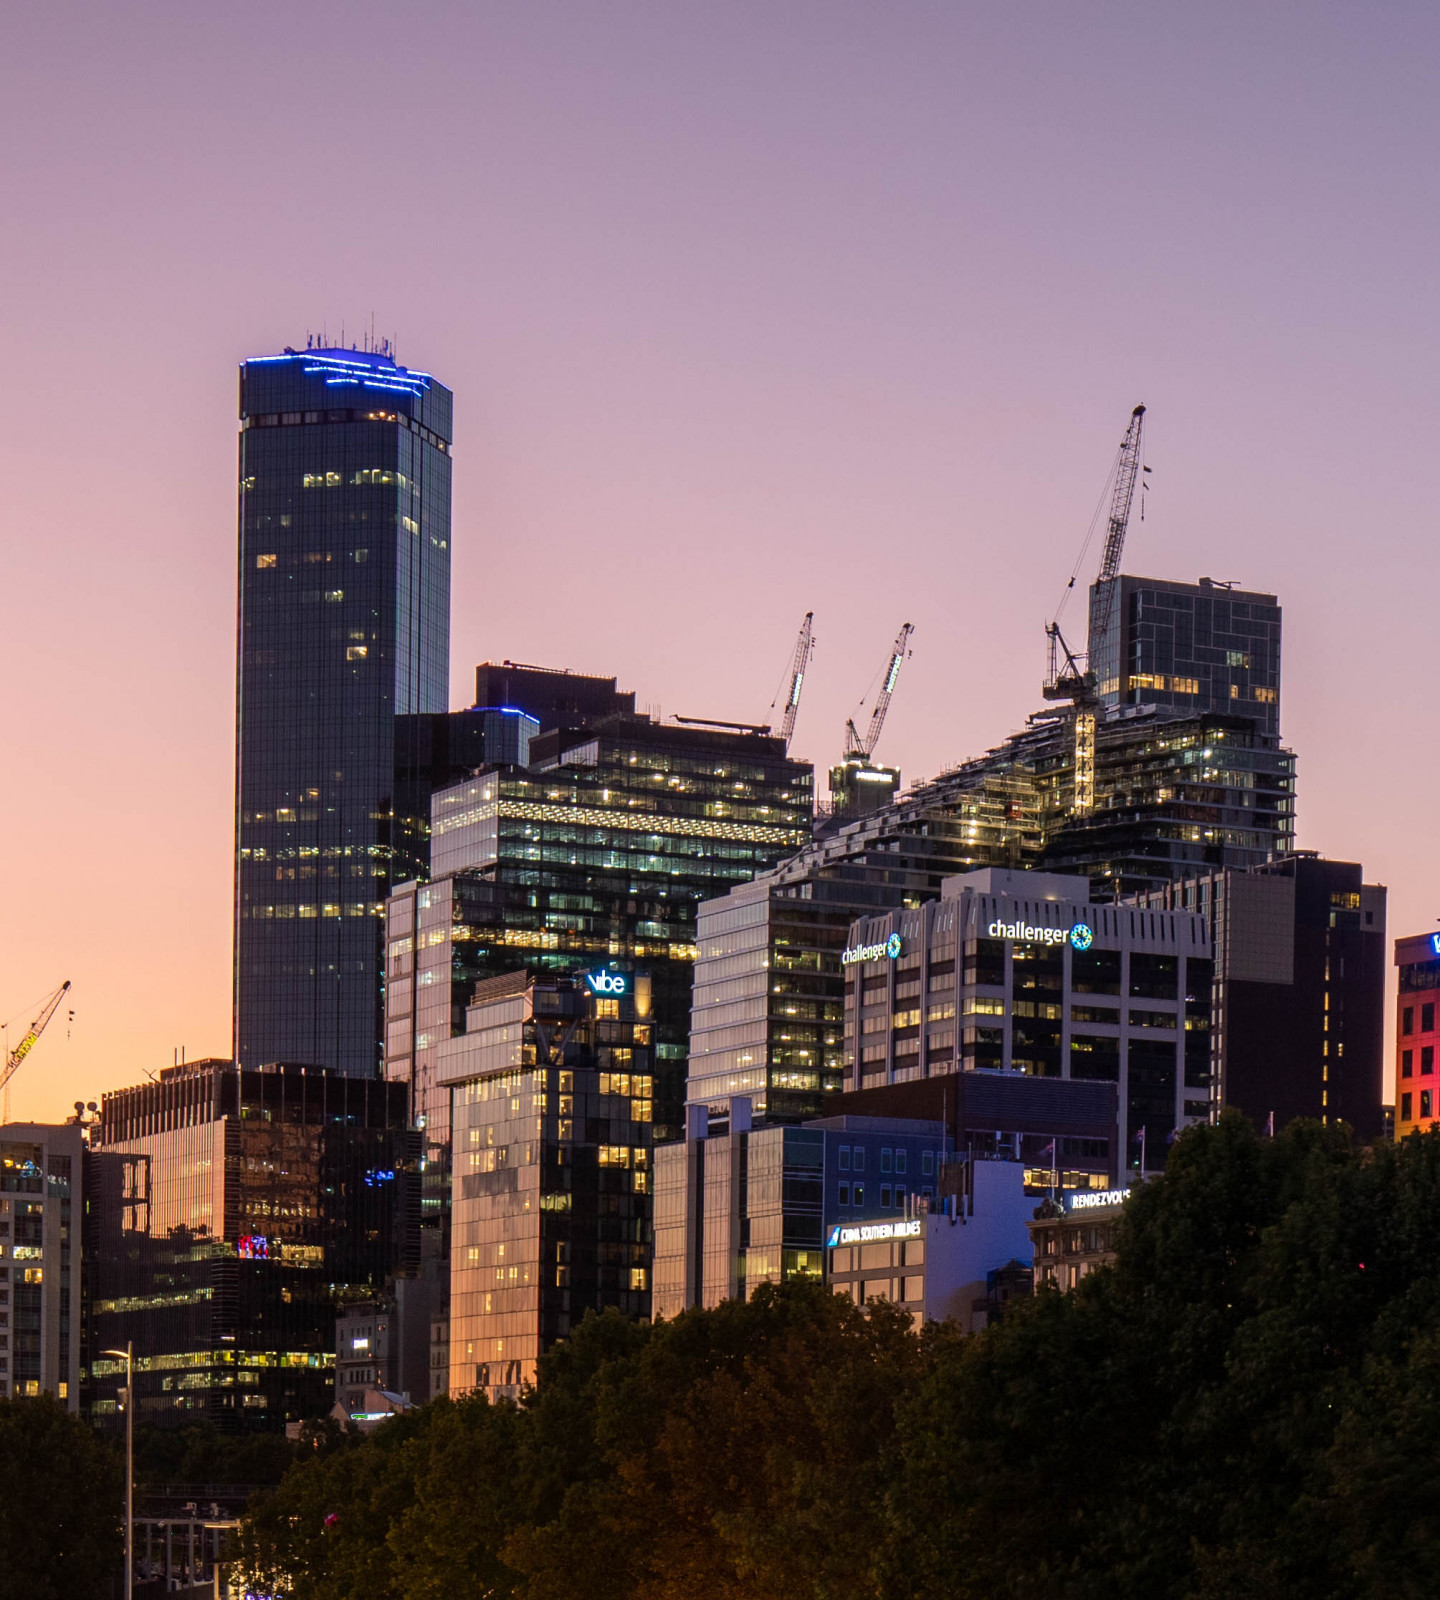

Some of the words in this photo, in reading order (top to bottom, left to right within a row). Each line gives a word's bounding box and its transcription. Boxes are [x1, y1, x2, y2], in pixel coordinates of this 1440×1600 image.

[988, 919, 1069, 945] challenger
[842, 941, 888, 964] challenger
[588, 969, 625, 993] vibe
